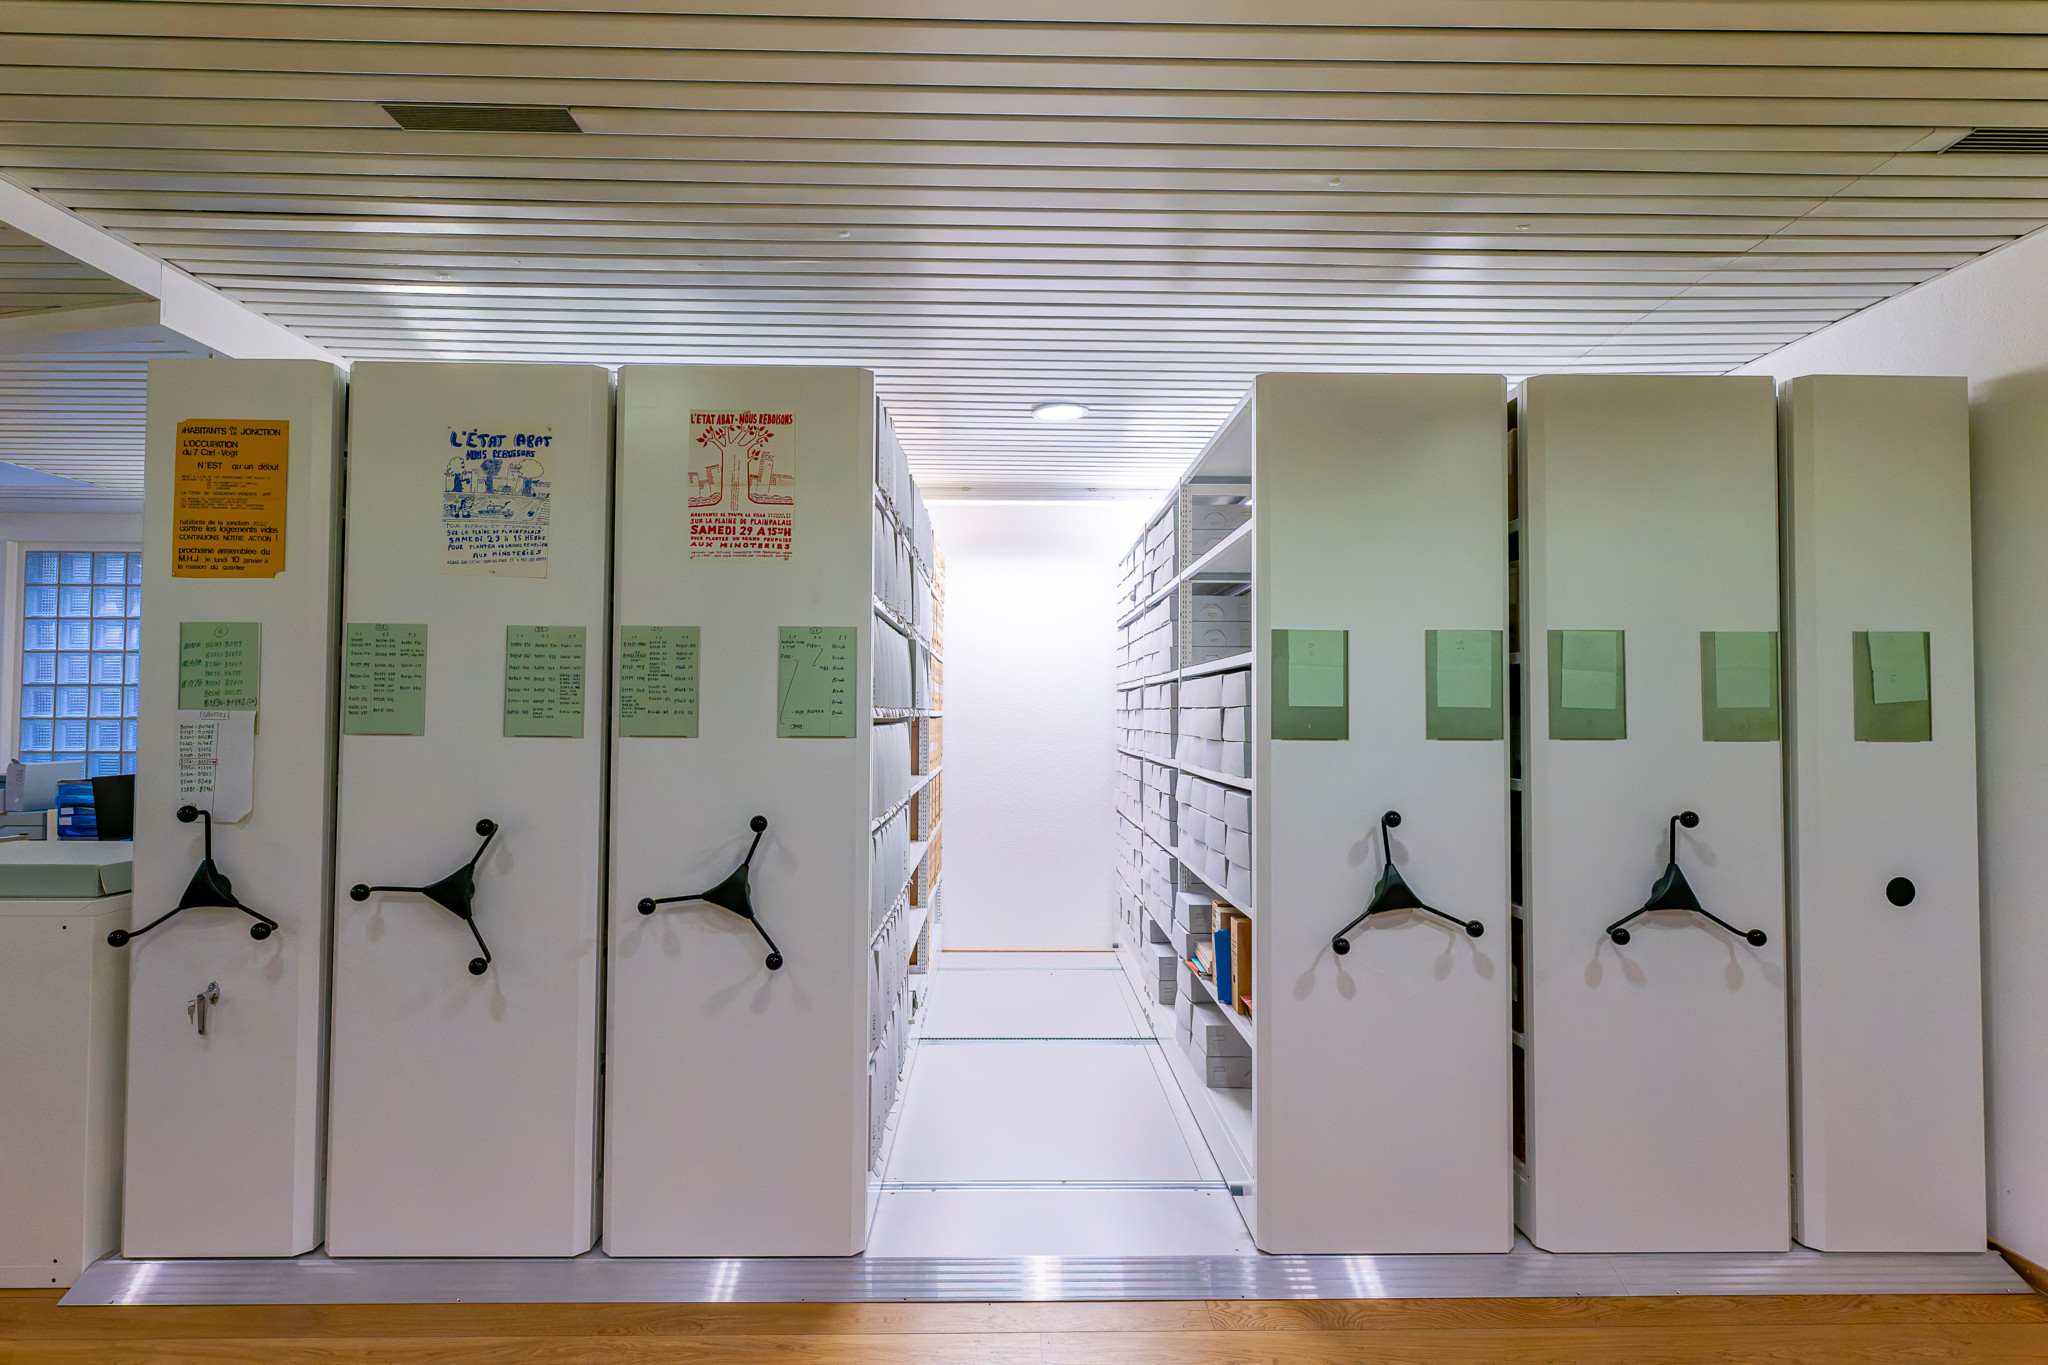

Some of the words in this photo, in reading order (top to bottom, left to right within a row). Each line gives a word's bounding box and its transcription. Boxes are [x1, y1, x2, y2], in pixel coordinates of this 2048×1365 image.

[716, 414, 735, 424] ABAT
[739, 414, 757, 424] NOUS
[759, 414, 793, 425] REBOISONS
[183, 440, 238, 448] L'OCCUPATION
[513, 433, 552, 448] ABAT
[221, 450, 238, 458] Vogt
[466, 450, 487, 460] NOUS
[220, 526, 257, 534] logements
[690, 525, 735, 535] SAMEDI
[739, 526, 753, 535] 29
[757, 527, 765, 536] A
